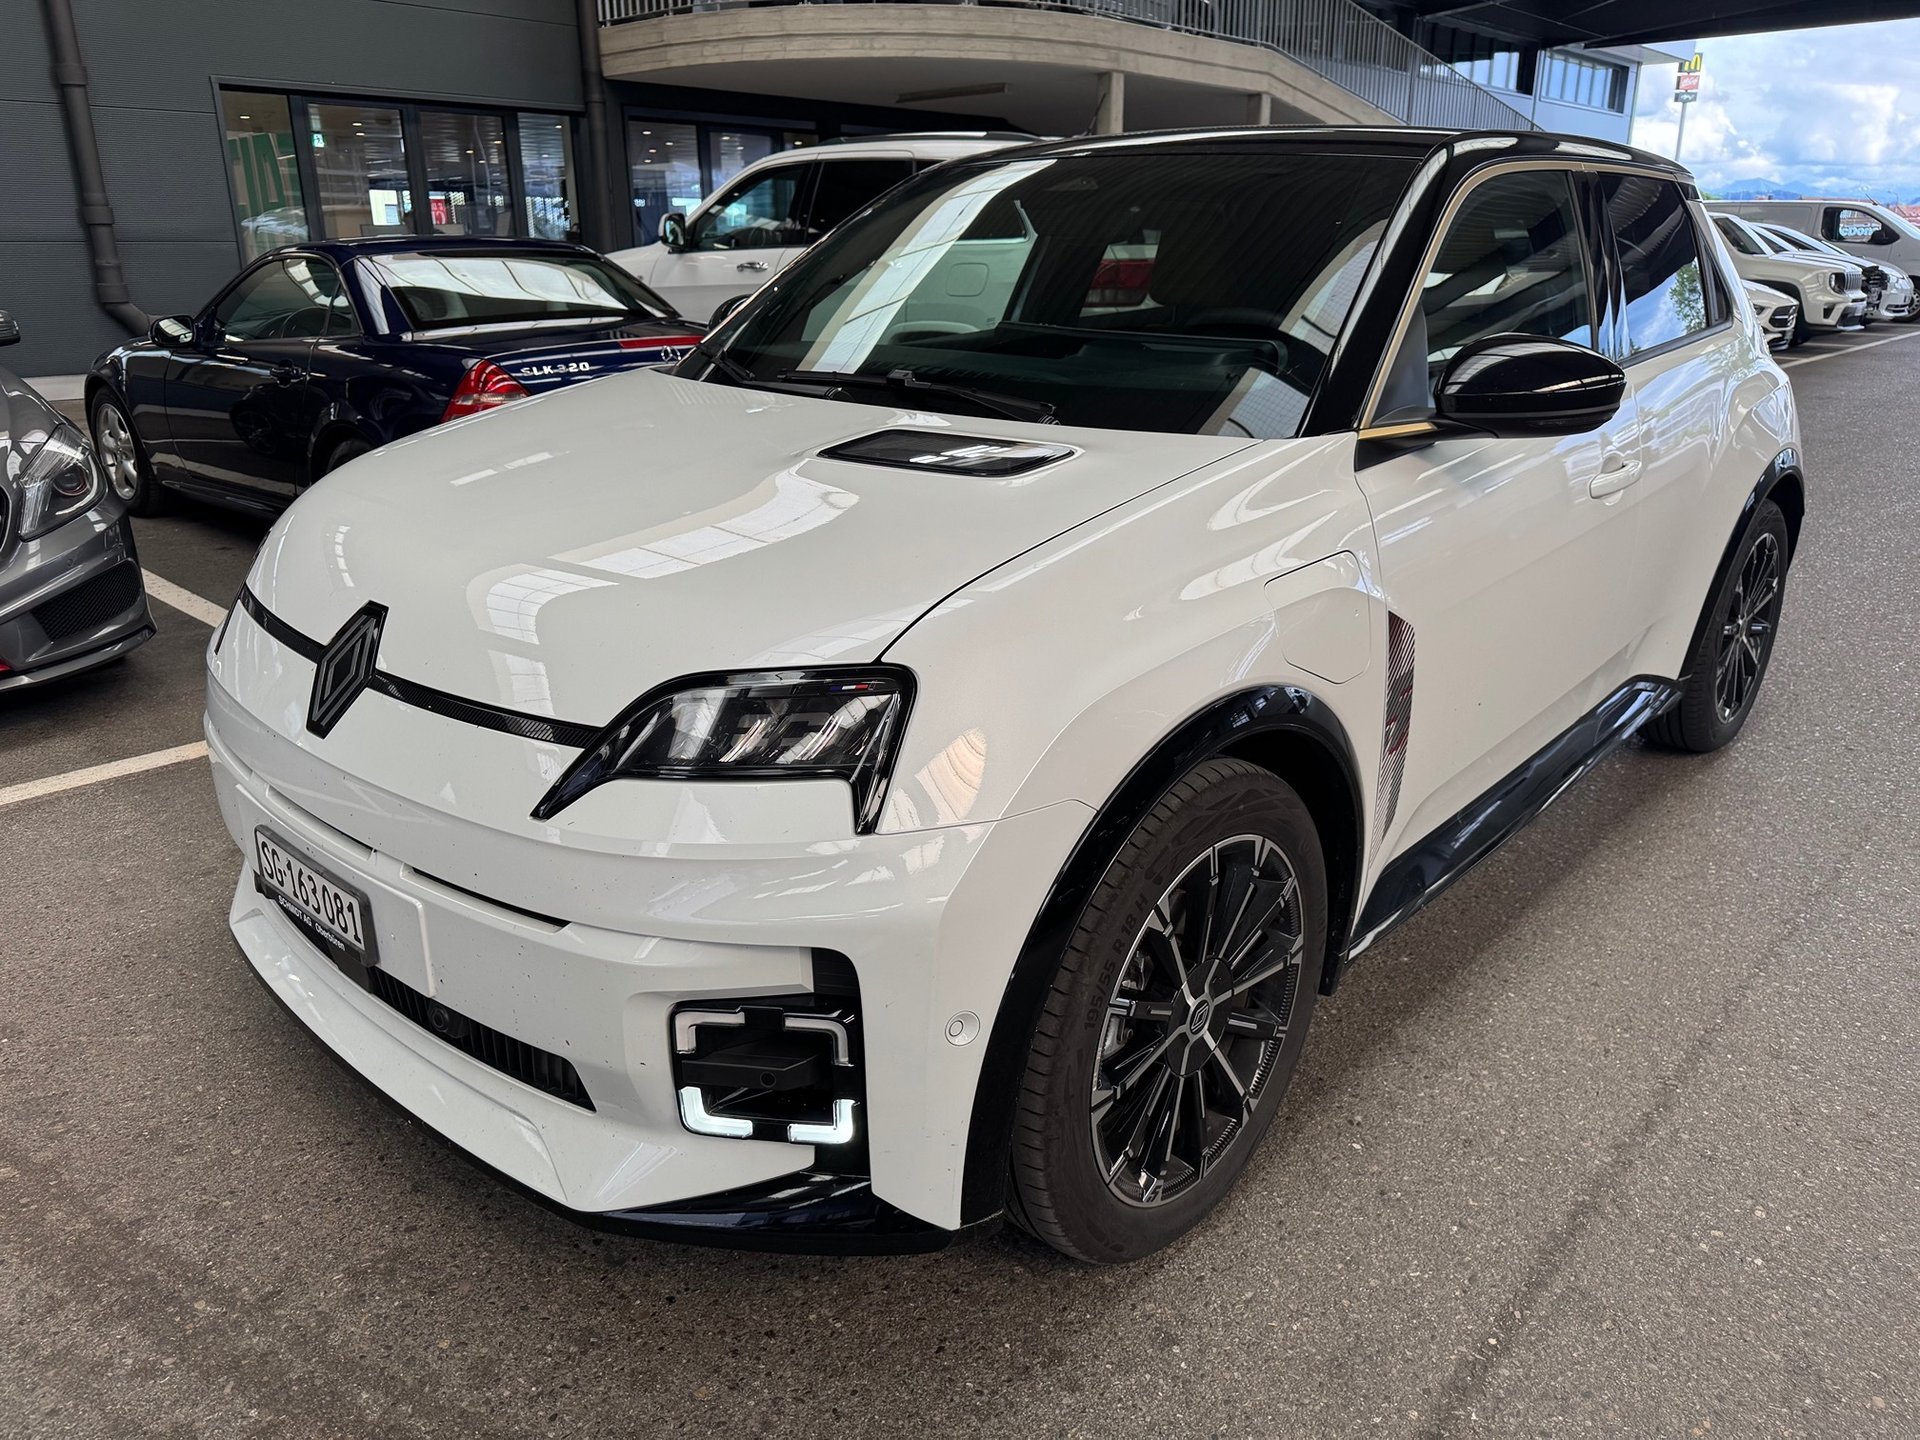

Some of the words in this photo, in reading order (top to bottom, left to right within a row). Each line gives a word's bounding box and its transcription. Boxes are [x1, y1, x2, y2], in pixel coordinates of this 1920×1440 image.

[520, 365, 554, 377] SLK
[557, 362, 591, 374] 320
[303, 913, 313, 927] AG
[315, 922, 346, 952] Oberbüren
[1084, 958, 1117, 1032] 195/55
[1111, 937, 1126, 955] R
[1120, 913, 1138, 937] 18
[1134, 892, 1149, 912] H
